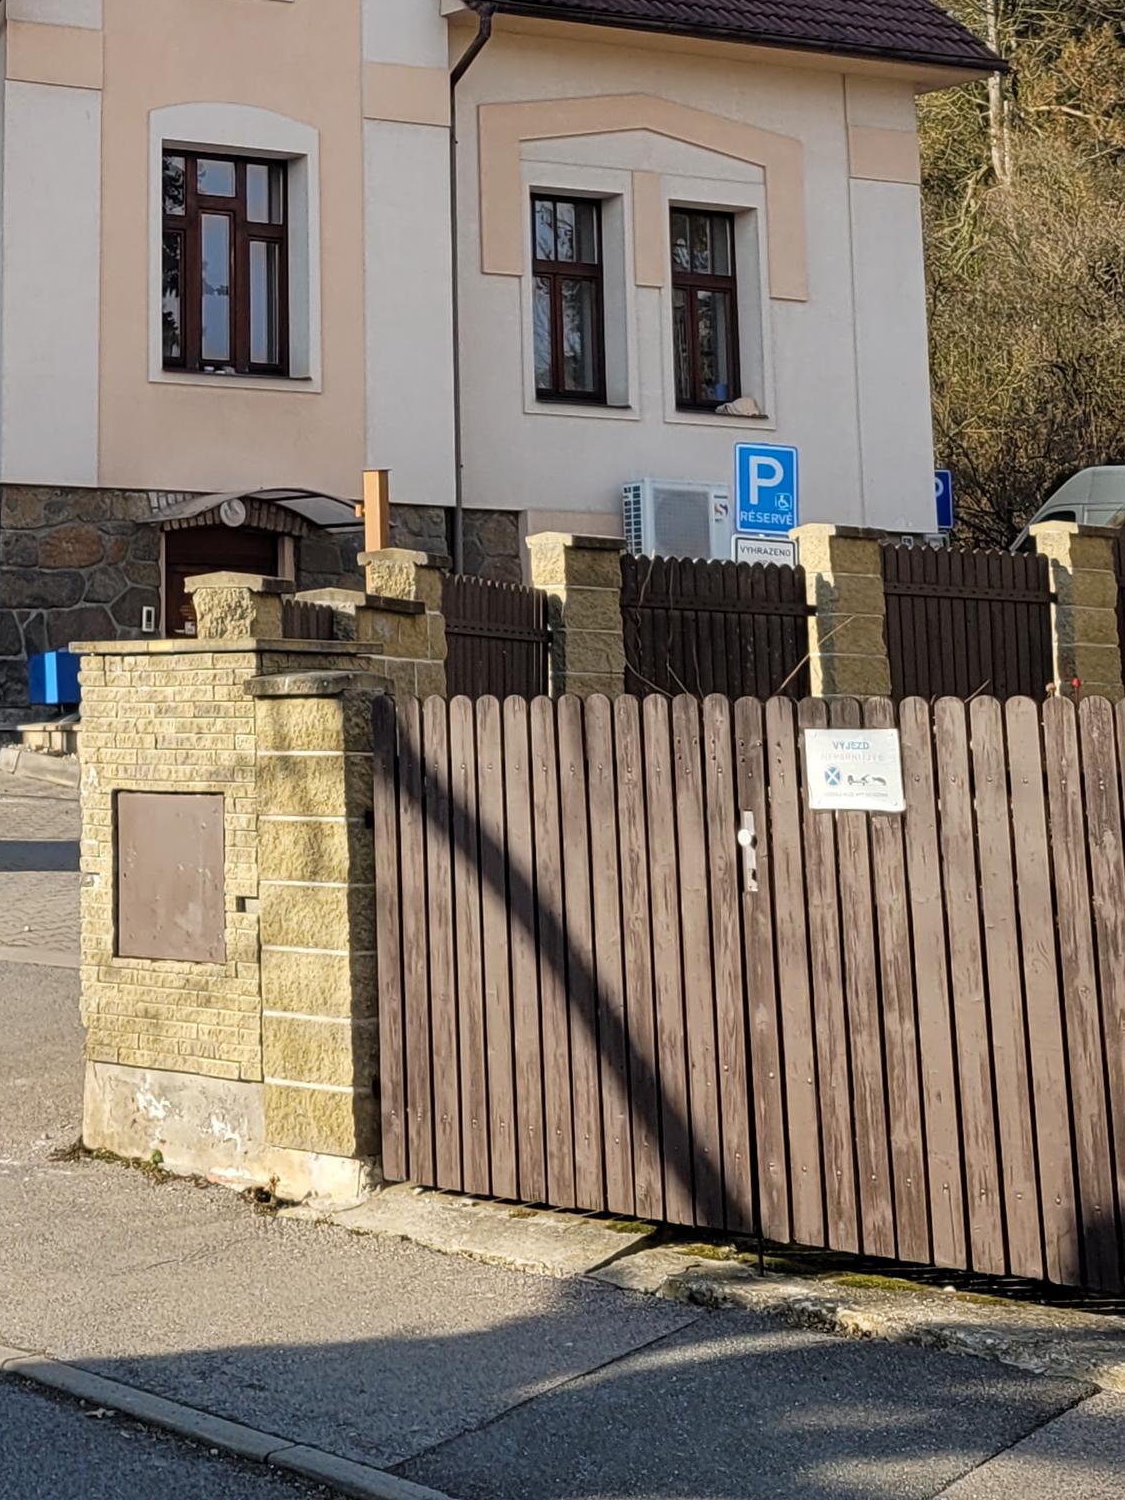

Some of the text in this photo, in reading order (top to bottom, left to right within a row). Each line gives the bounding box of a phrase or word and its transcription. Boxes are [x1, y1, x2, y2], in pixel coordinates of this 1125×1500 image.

[749, 455, 784, 505] P
[740, 545, 792, 557] VYHRAZENO
[832, 740, 870, 750] VÝJEZD
